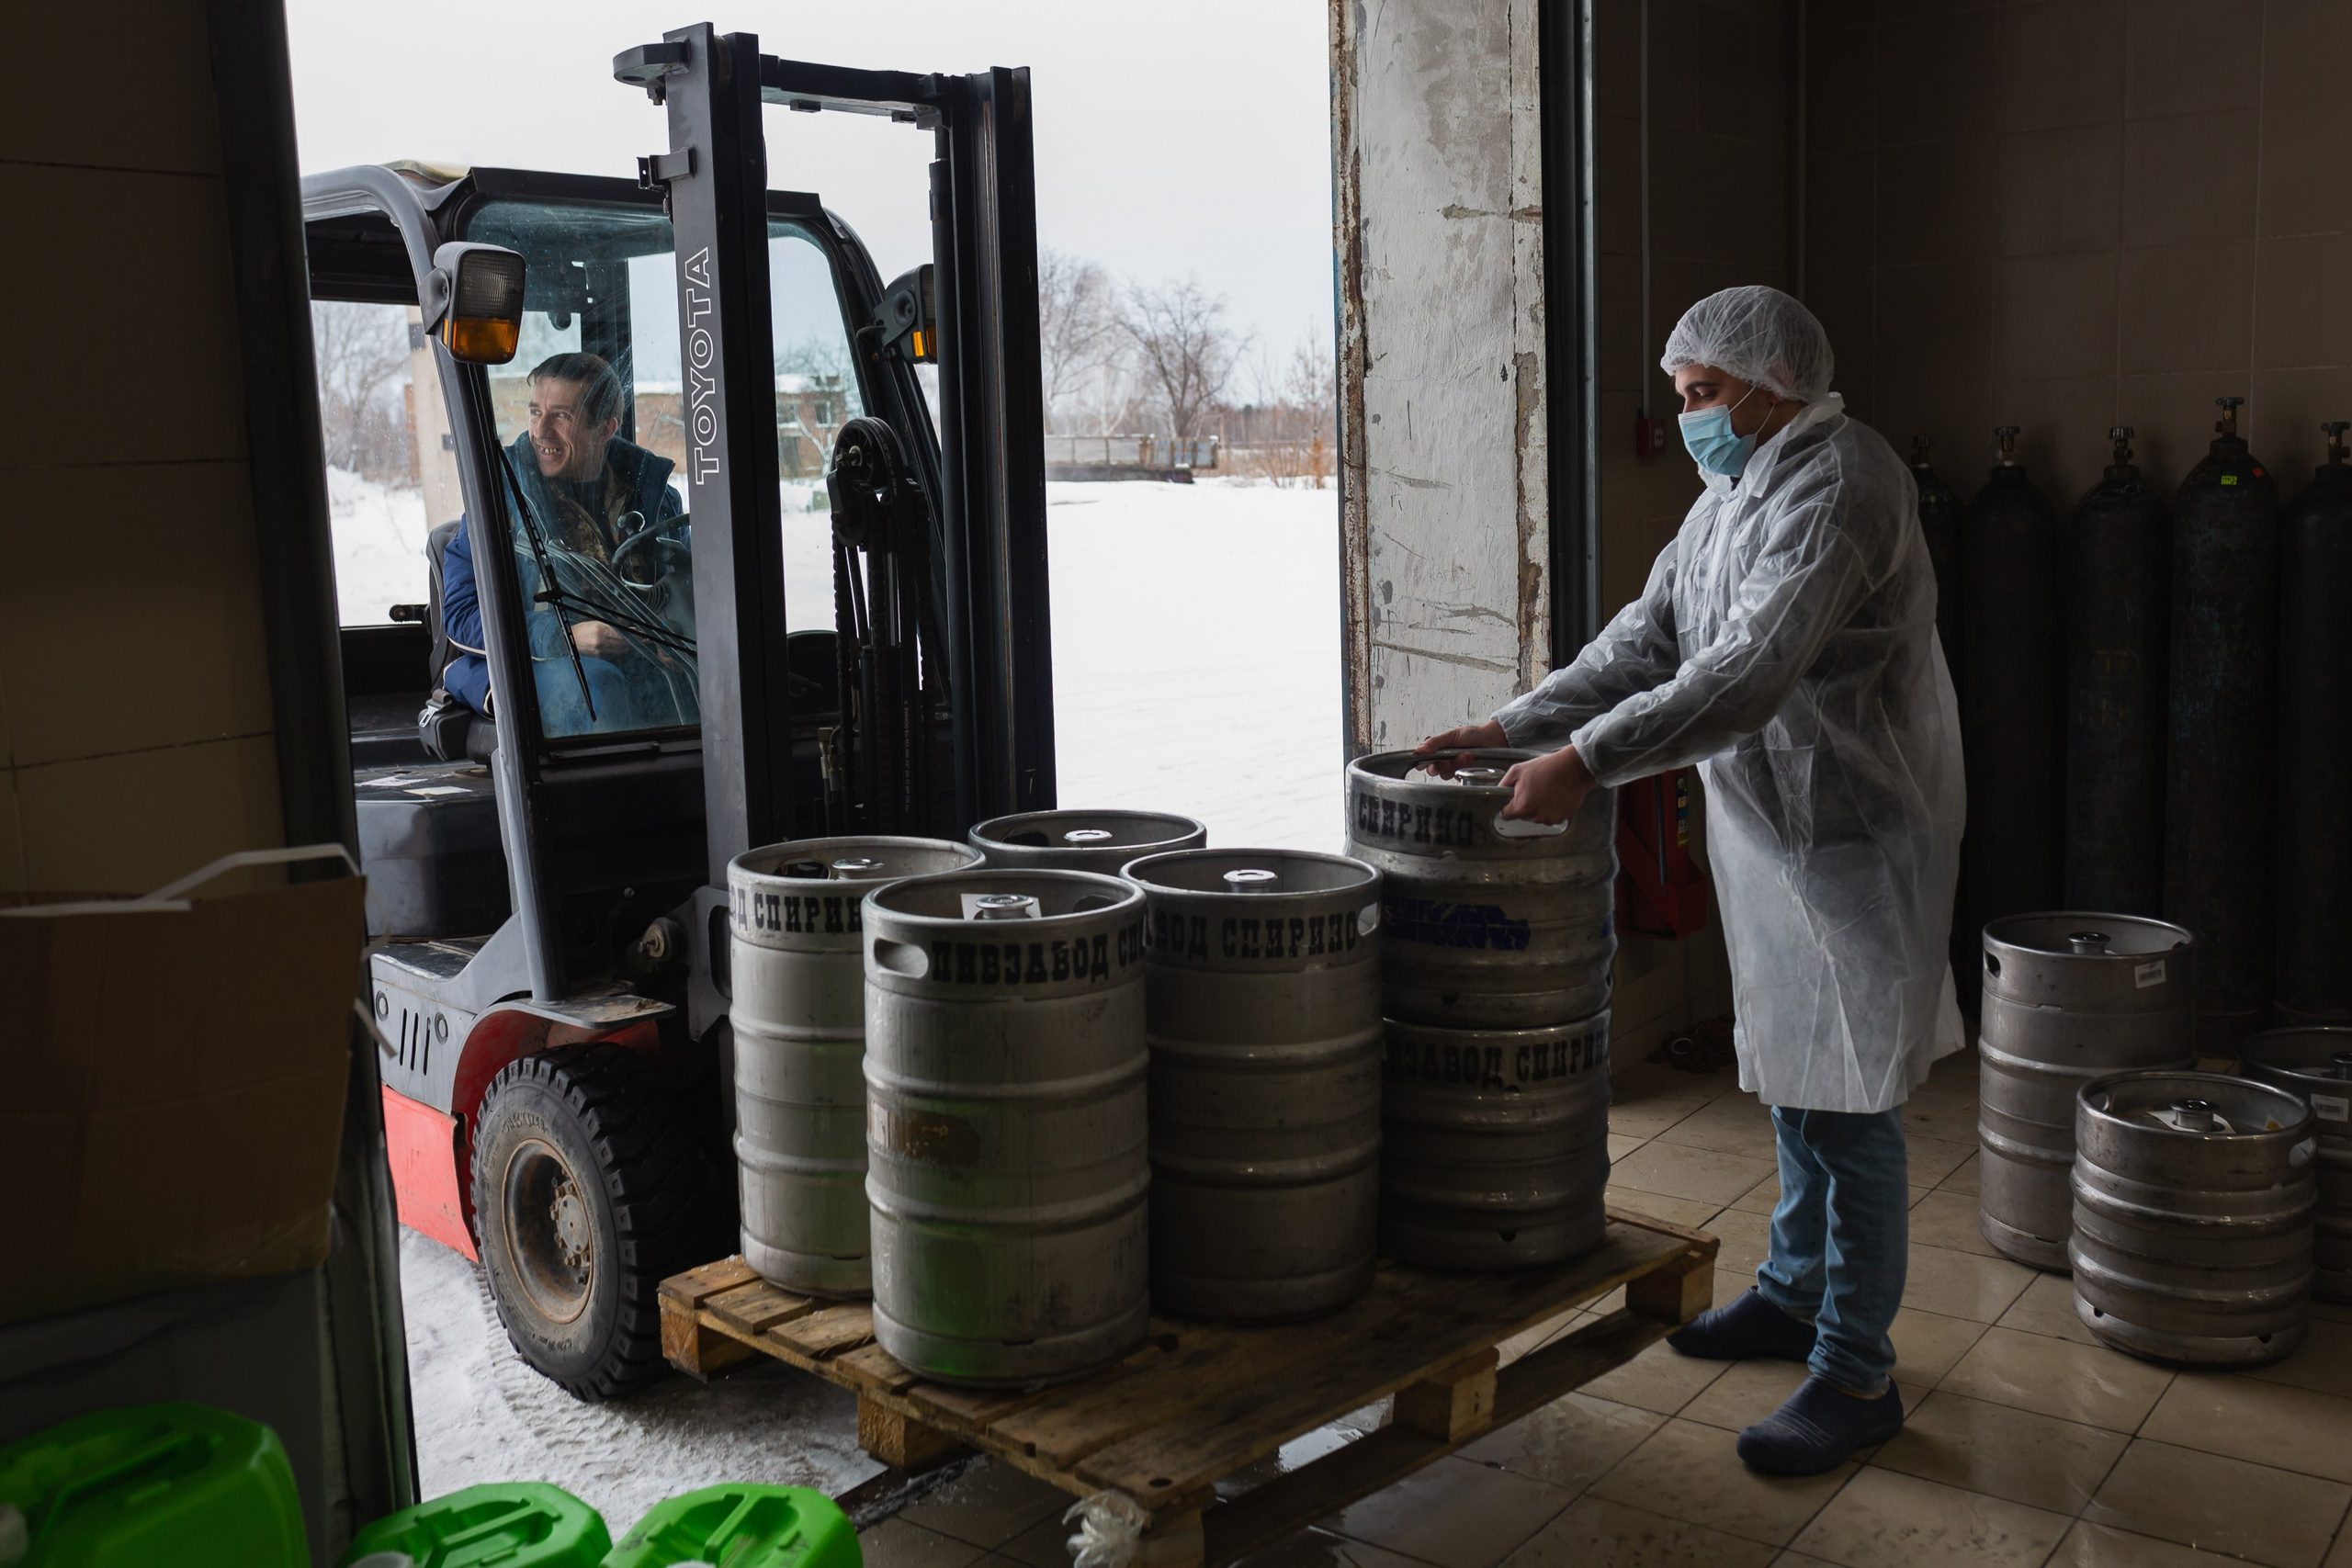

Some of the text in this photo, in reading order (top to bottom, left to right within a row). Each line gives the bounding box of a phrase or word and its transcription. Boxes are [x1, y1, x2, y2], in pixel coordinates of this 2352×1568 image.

[684, 246, 719, 485] TOYOTA
[1359, 793, 1474, 848] СПИРИНО
[932, 933, 1108, 984] ПИВЗАВОД
[1222, 910, 1356, 957] СПИРИНО
